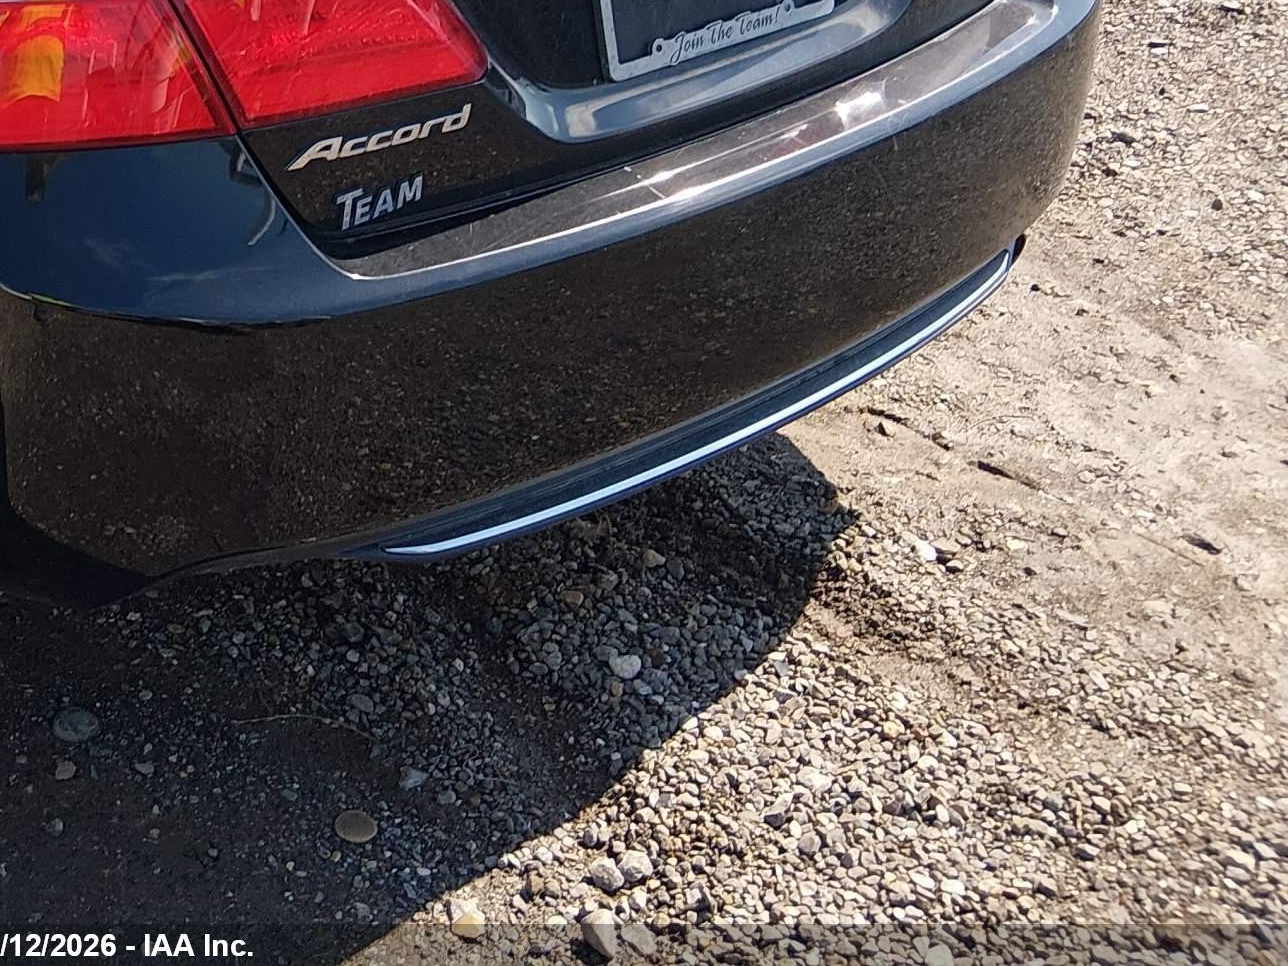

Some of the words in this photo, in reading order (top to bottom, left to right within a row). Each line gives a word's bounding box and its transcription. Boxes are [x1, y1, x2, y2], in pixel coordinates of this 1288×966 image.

[670, 33, 704, 64] Join
[283, 103, 472, 171] Accord
[335, 175, 424, 231] TEAM
